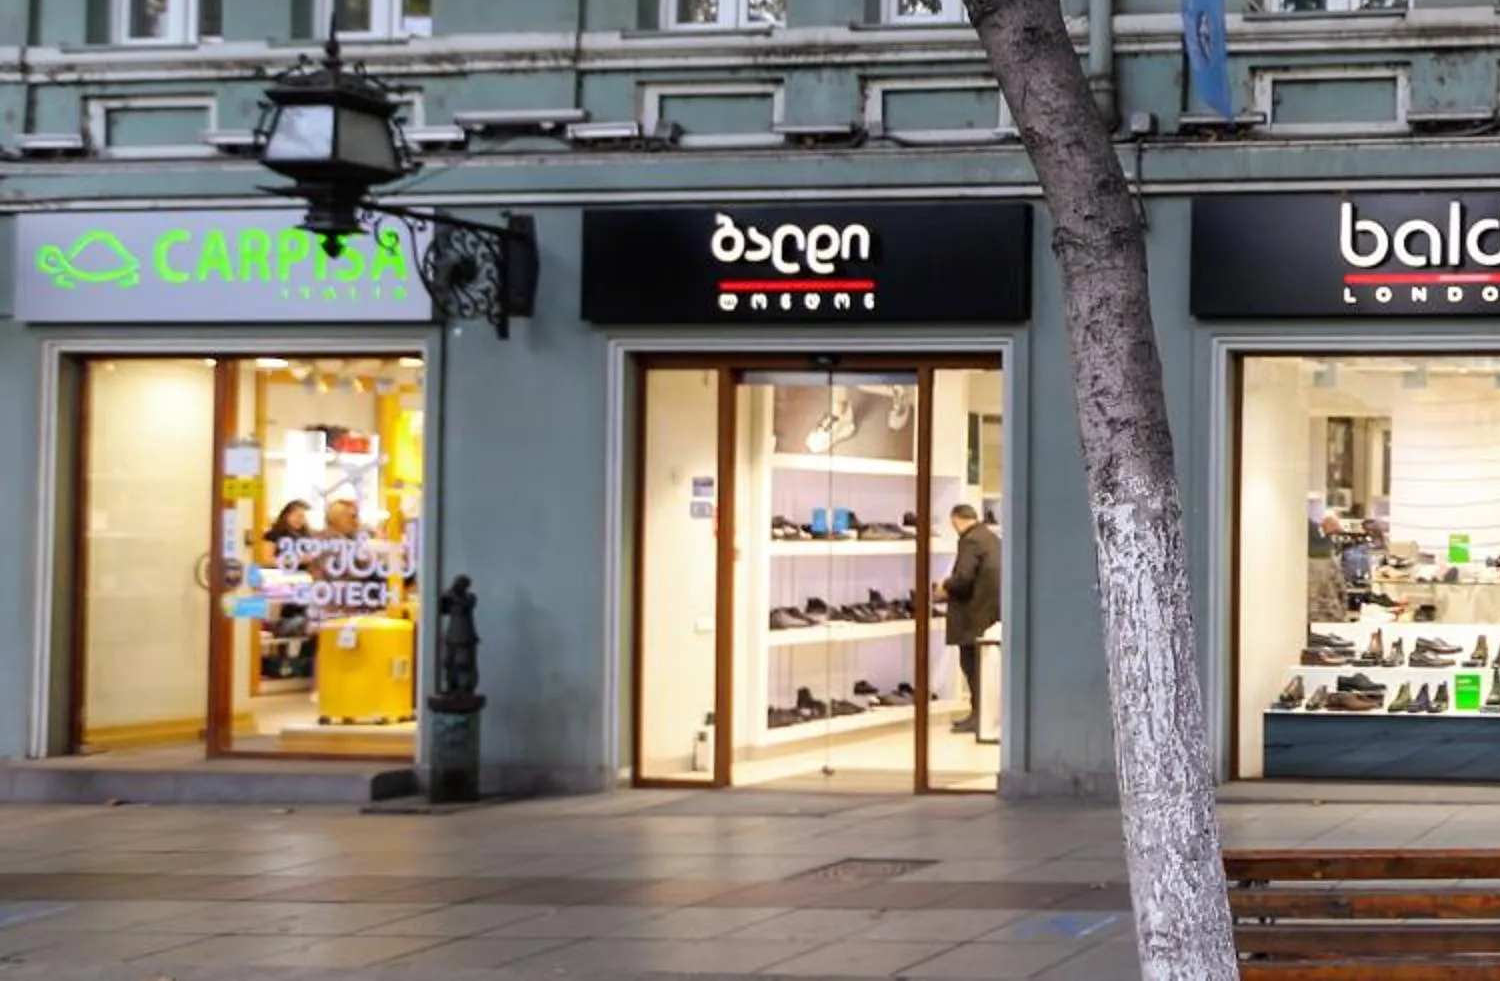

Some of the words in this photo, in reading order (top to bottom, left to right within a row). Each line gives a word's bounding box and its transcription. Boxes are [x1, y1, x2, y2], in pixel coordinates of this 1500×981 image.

[152, 227, 409, 284] CARPISA
[711, 213, 871, 274] ბალდი
[717, 292, 876, 311] ლონდონ
[293, 581, 401, 607] GOTECH
